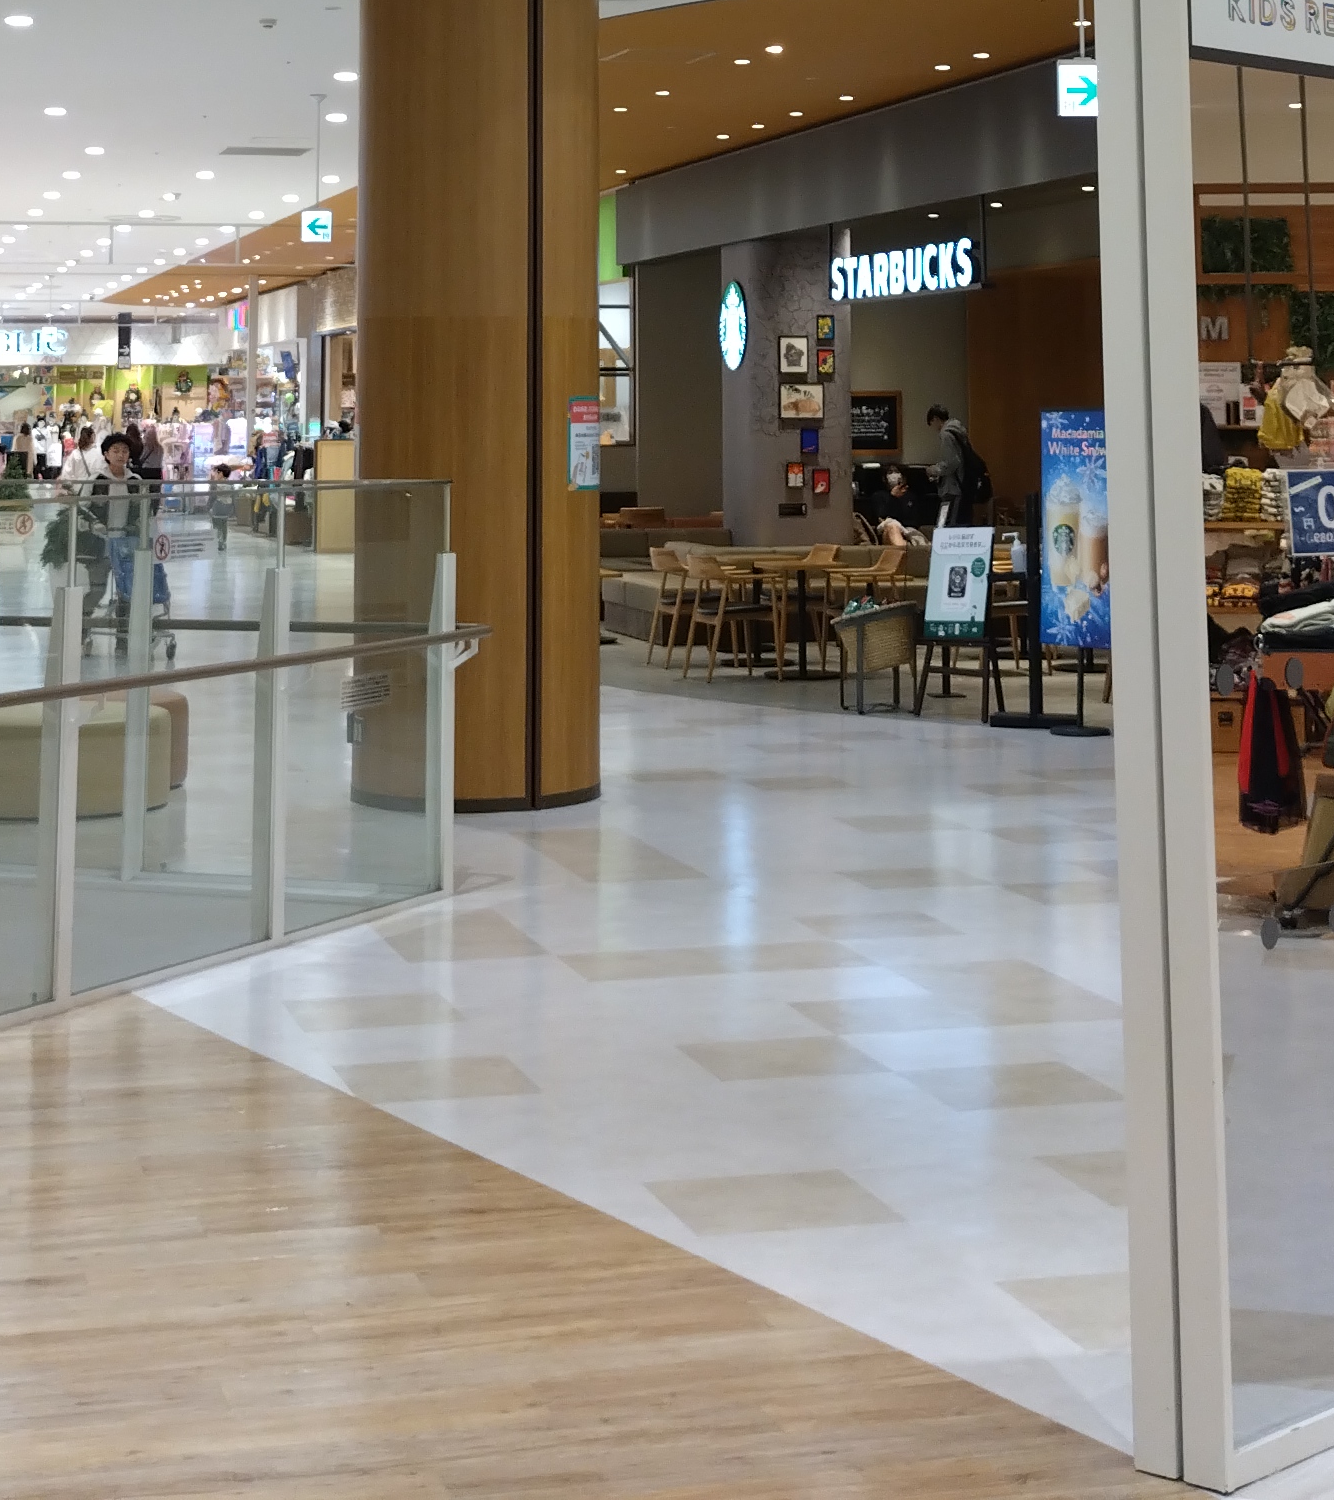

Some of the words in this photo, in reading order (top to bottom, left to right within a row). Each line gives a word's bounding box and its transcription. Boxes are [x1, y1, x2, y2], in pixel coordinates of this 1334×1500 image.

[830, 237, 974, 302] STARBUCKS
[1051, 426, 1105, 439] Macadamia
[1048, 440, 1080, 456] White
